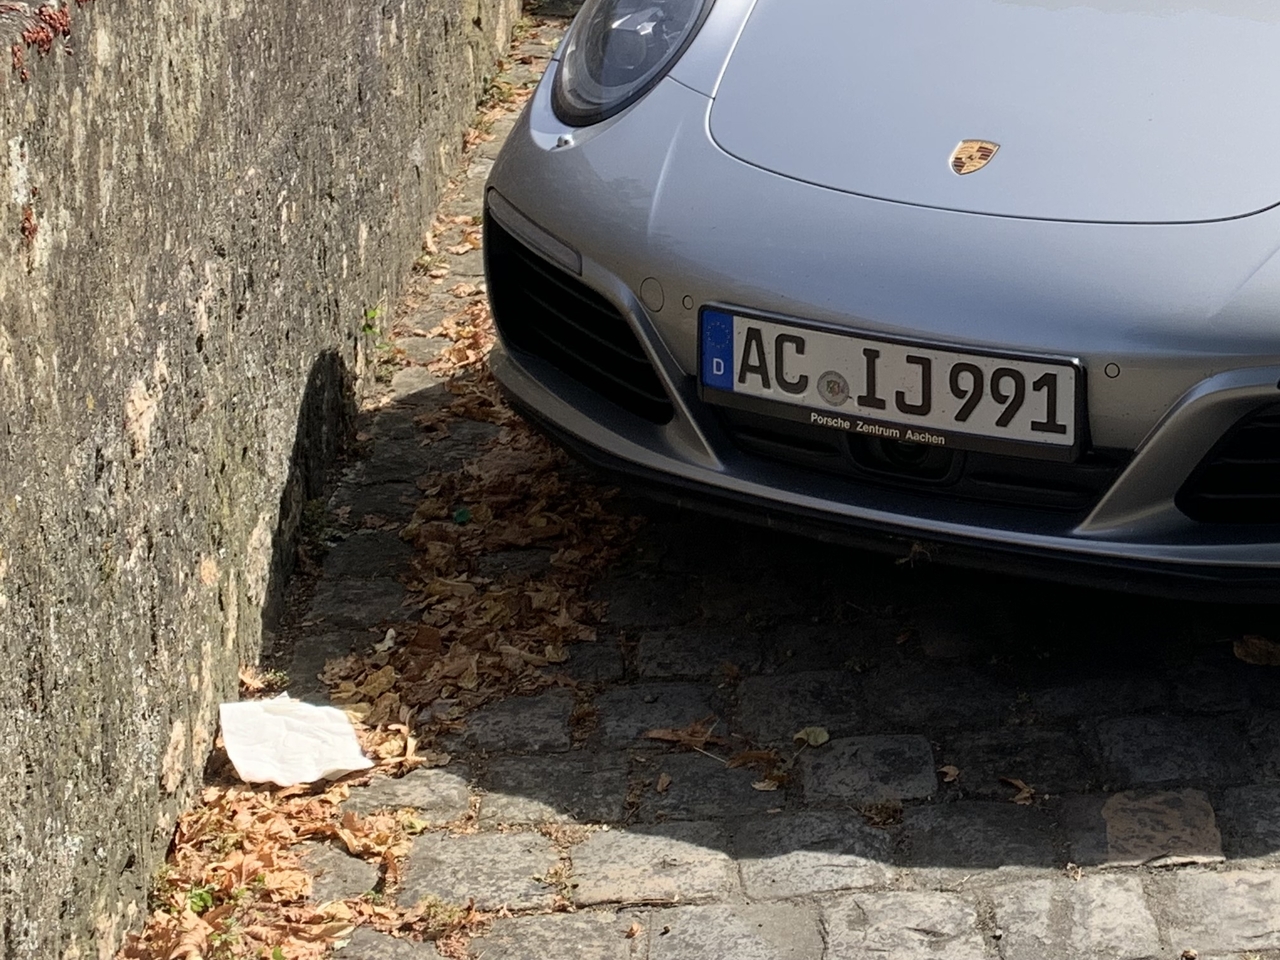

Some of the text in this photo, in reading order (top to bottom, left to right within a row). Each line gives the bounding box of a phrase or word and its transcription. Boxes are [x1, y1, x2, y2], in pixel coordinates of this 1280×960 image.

[712, 357, 725, 376] D
[737, 327, 809, 395] AC
[810, 412, 946, 446] Porsche Zentrum Aachen
